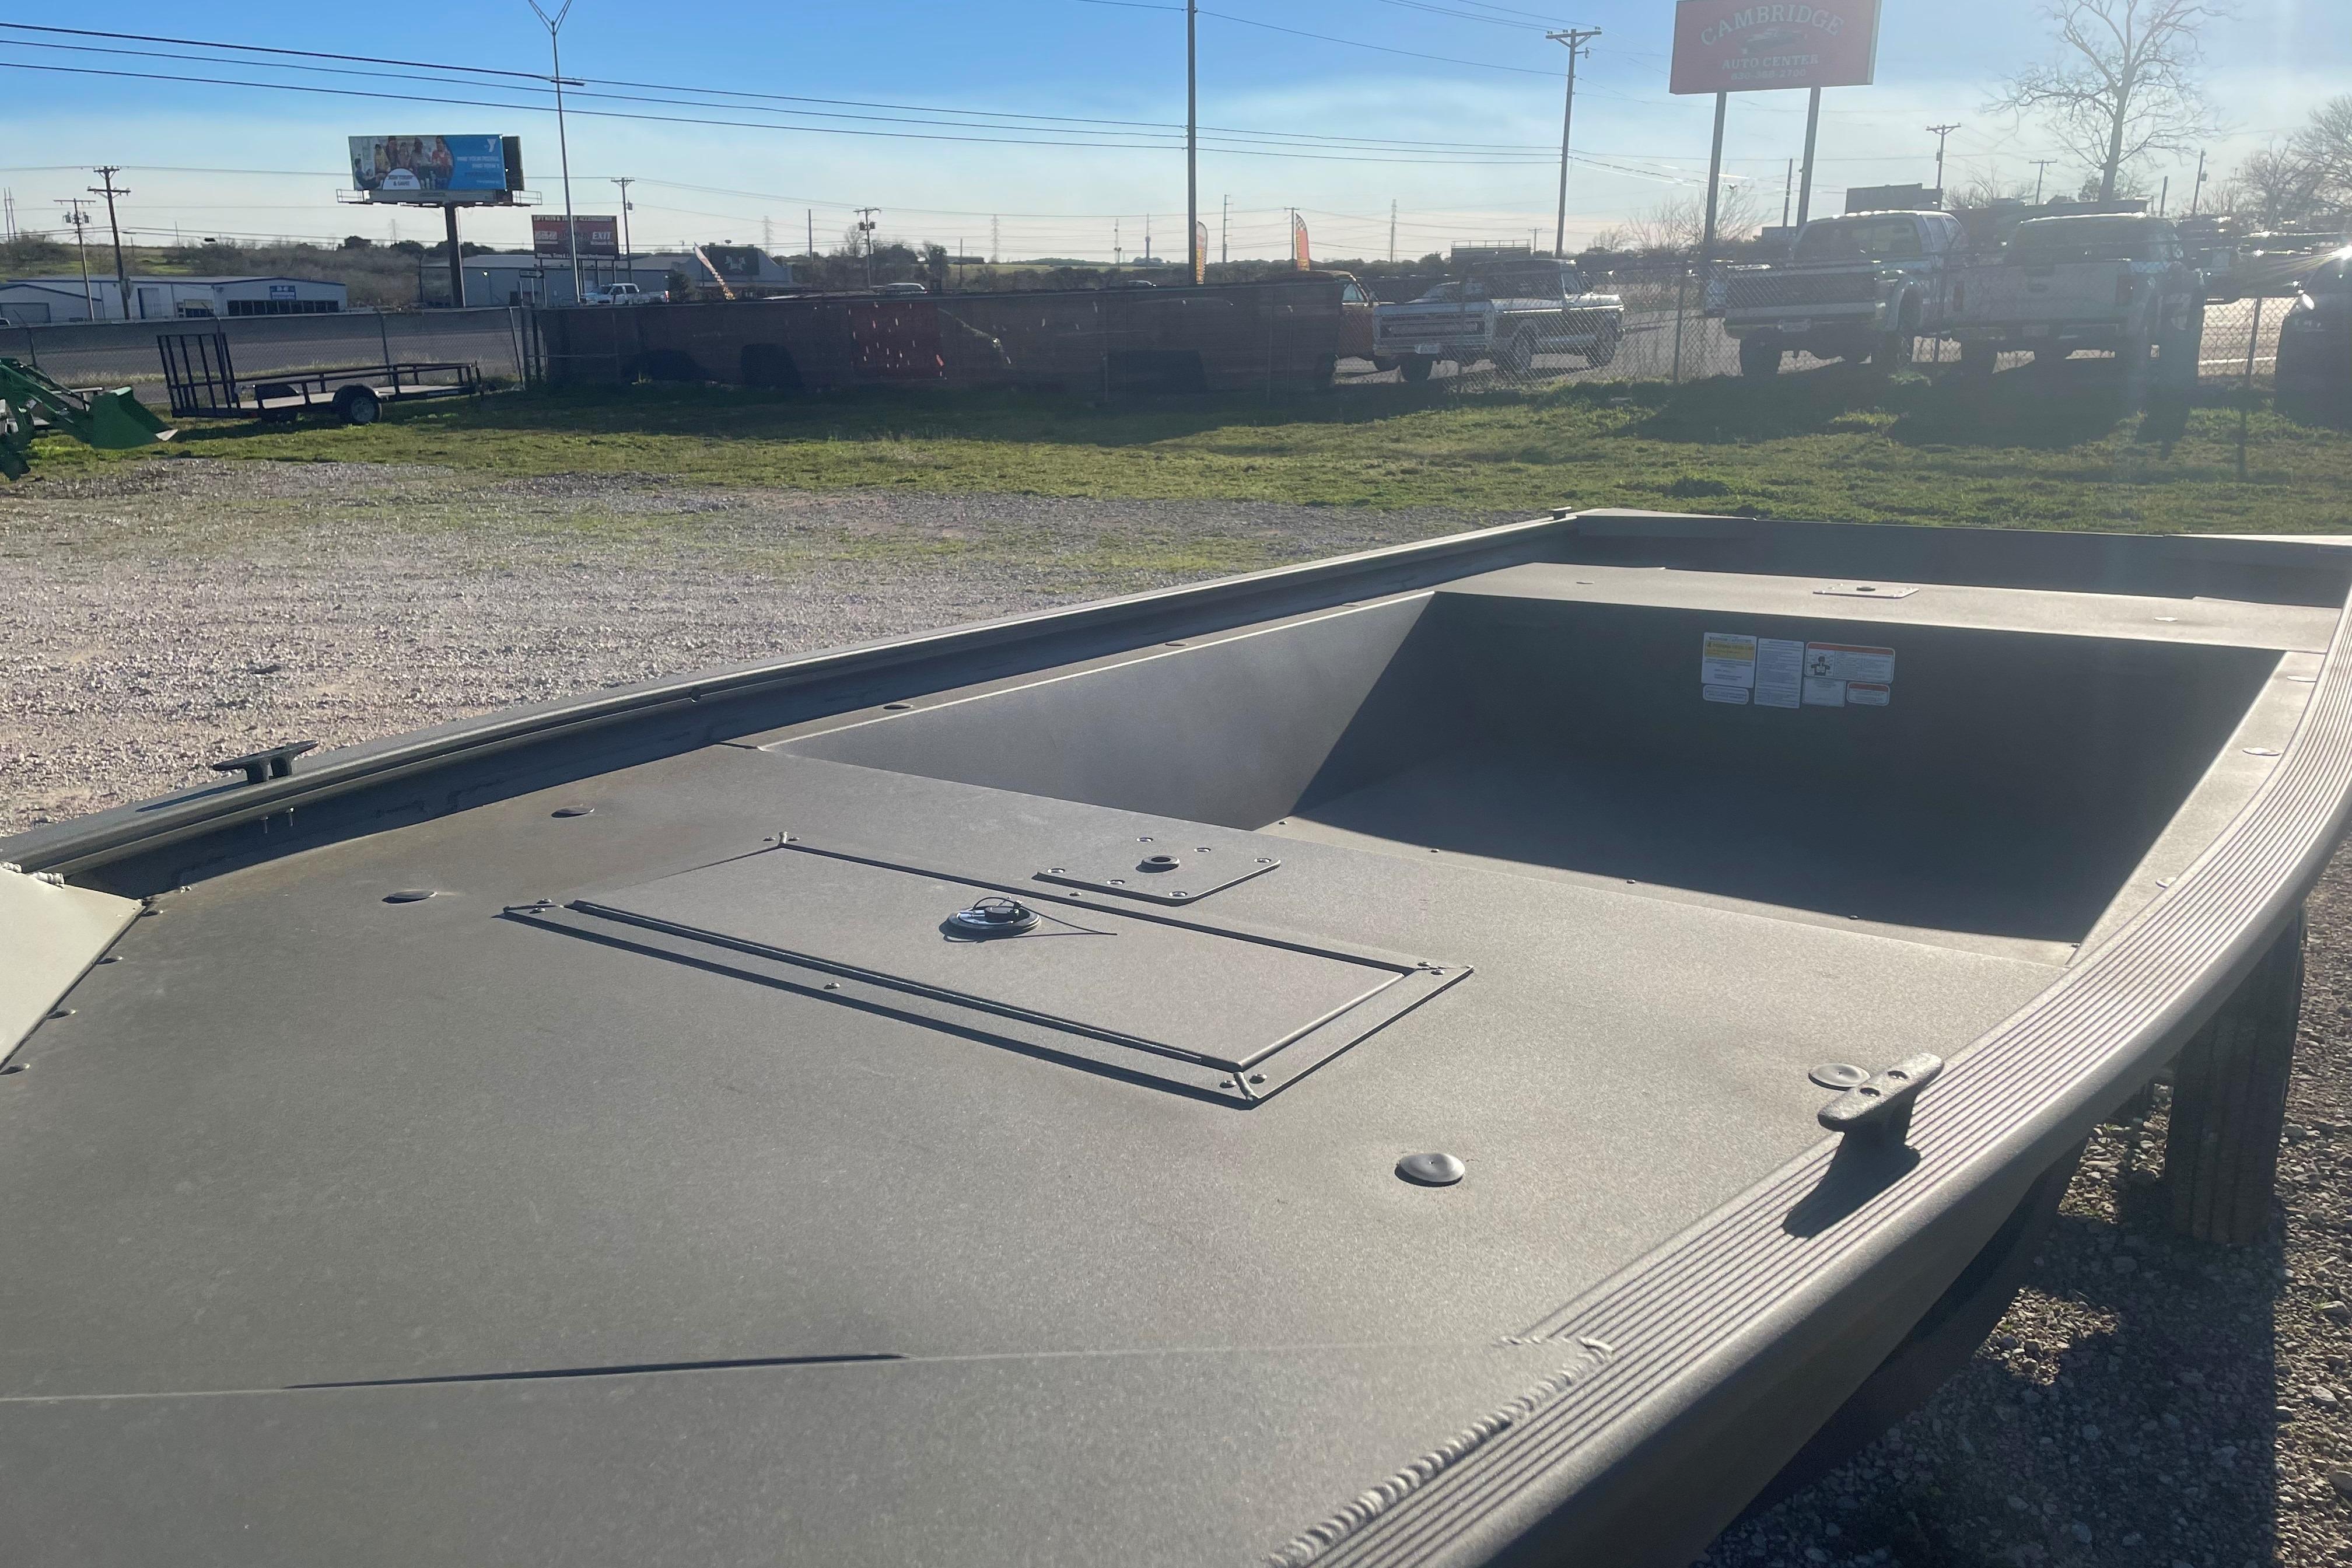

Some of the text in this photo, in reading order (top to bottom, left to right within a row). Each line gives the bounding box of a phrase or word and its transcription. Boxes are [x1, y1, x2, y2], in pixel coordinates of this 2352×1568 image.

[1701, 4, 1844, 46] CAMBRIDGE
[1721, 54, 1819, 71] AUTO CENTER
[592, 231, 612, 240] EXIT
